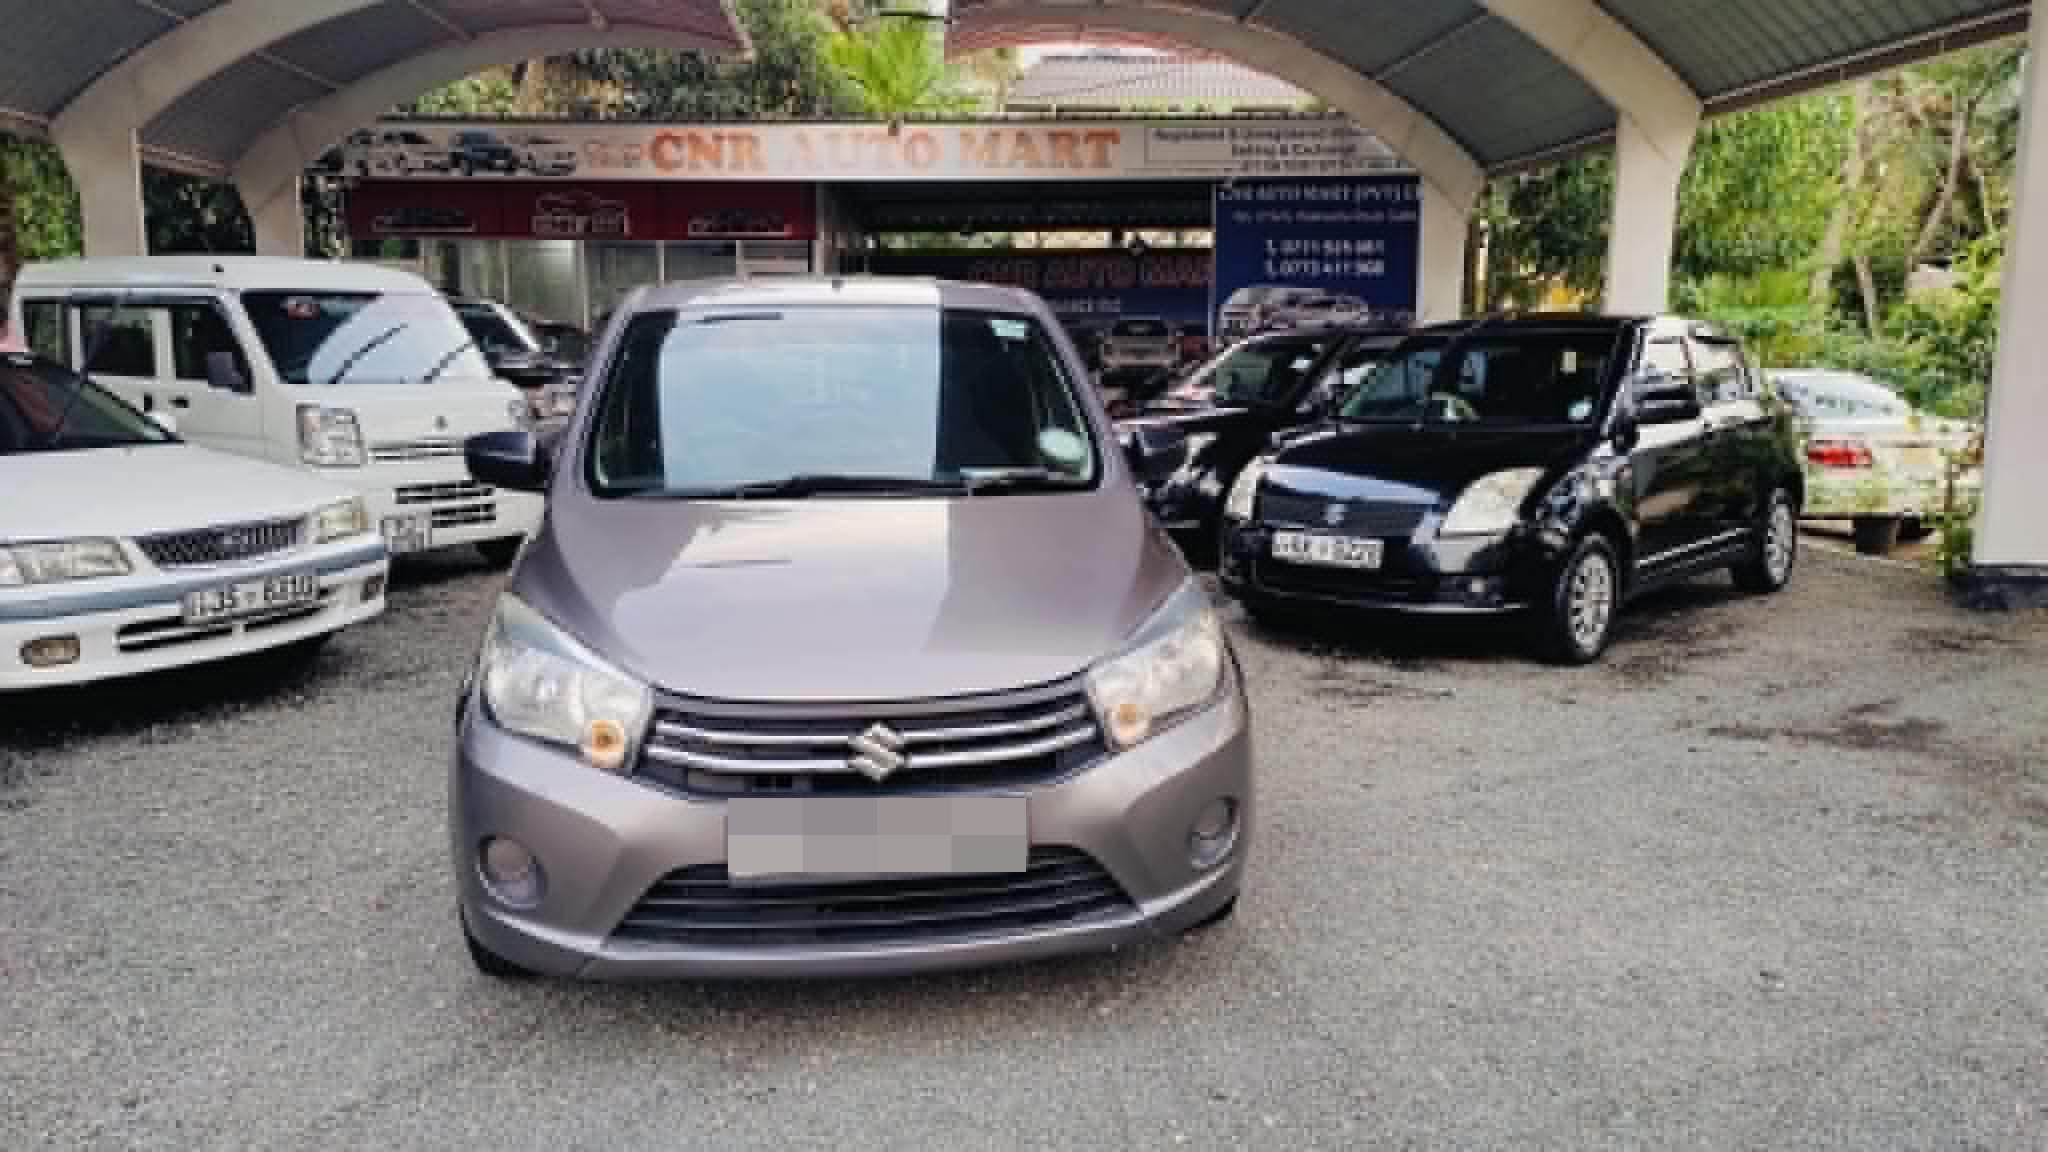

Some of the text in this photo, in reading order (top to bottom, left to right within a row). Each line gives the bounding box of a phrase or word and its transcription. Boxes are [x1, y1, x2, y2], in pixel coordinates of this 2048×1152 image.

[649, 128, 765, 172] CNR
[789, 127, 941, 170] AUTO
[960, 128, 1120, 169] MART
[1256, 182, 1300, 201] AUTO
[1303, 182, 1350, 201] MART
[1043, 256, 1137, 288] AUTO
